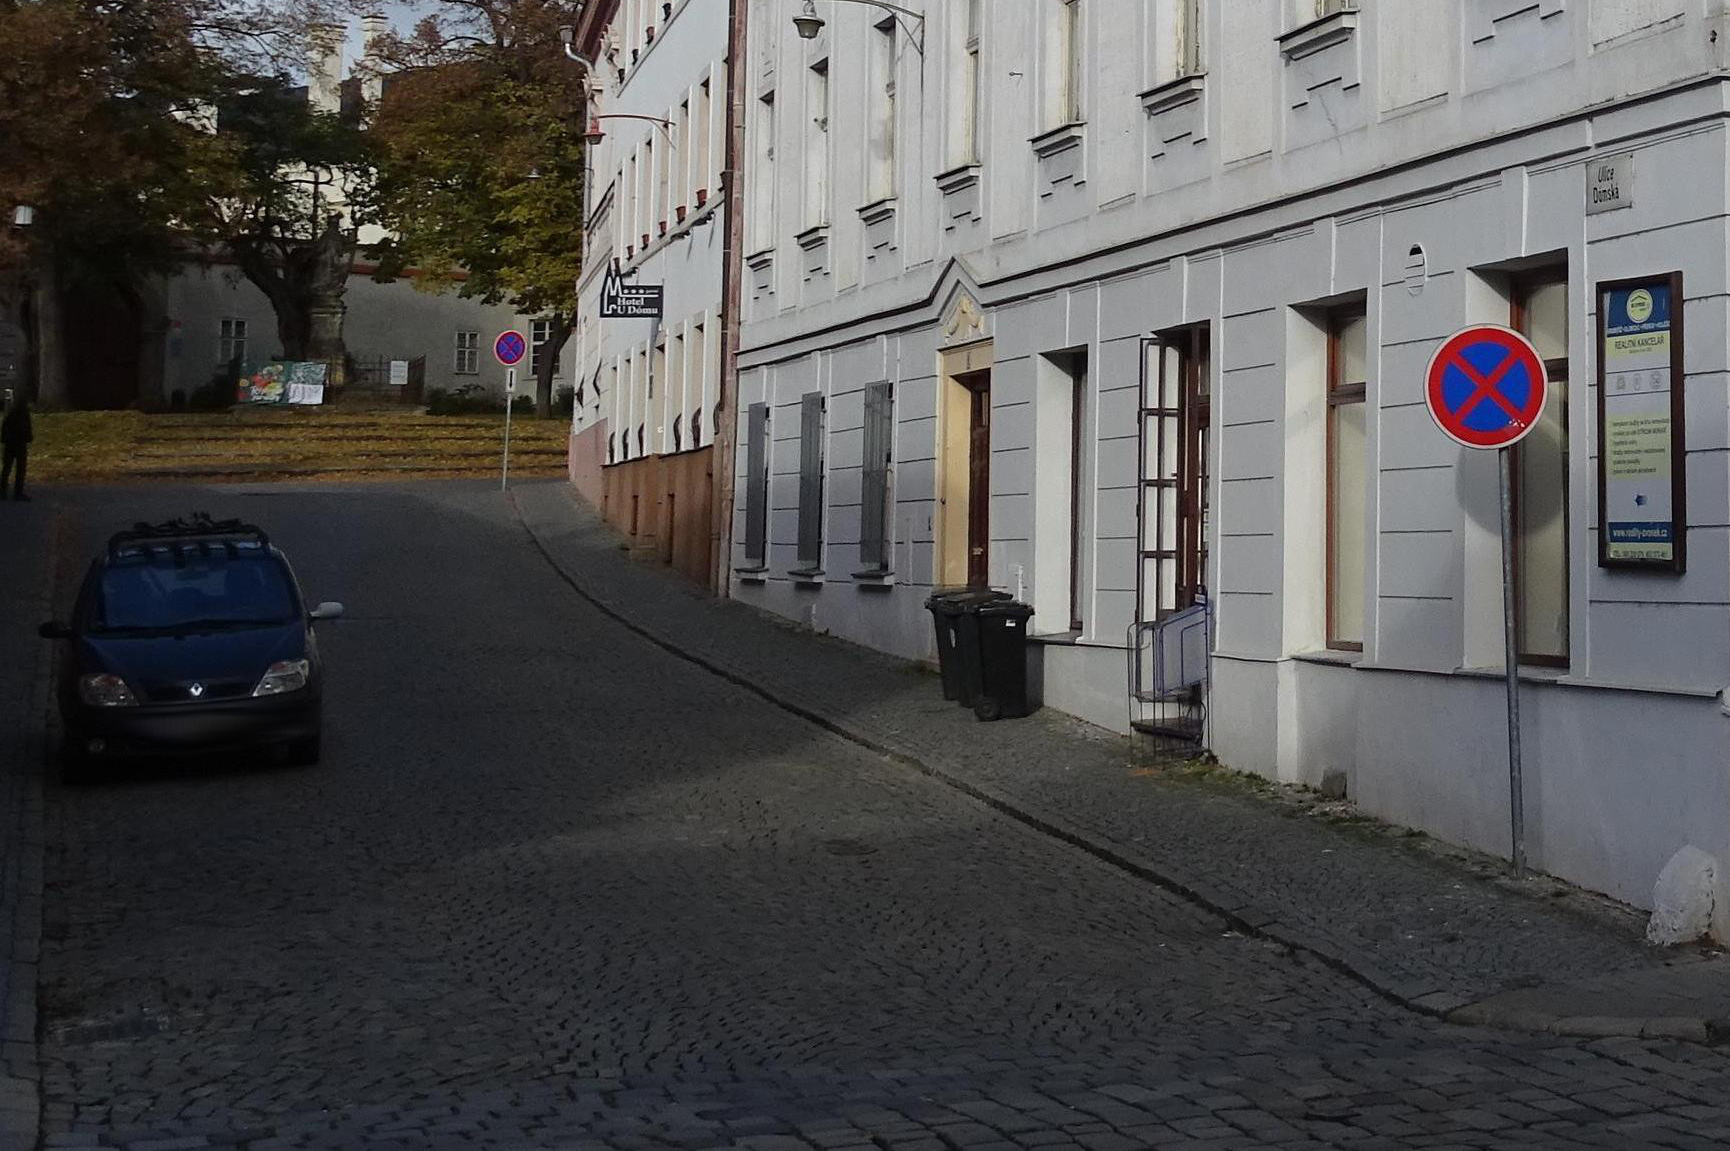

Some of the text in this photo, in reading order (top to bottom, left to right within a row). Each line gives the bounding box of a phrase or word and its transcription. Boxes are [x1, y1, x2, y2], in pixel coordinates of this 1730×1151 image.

[1598, 166, 1614, 182] Ulice
[617, 297, 645, 305] Hotel
[617, 306, 626, 314] U
